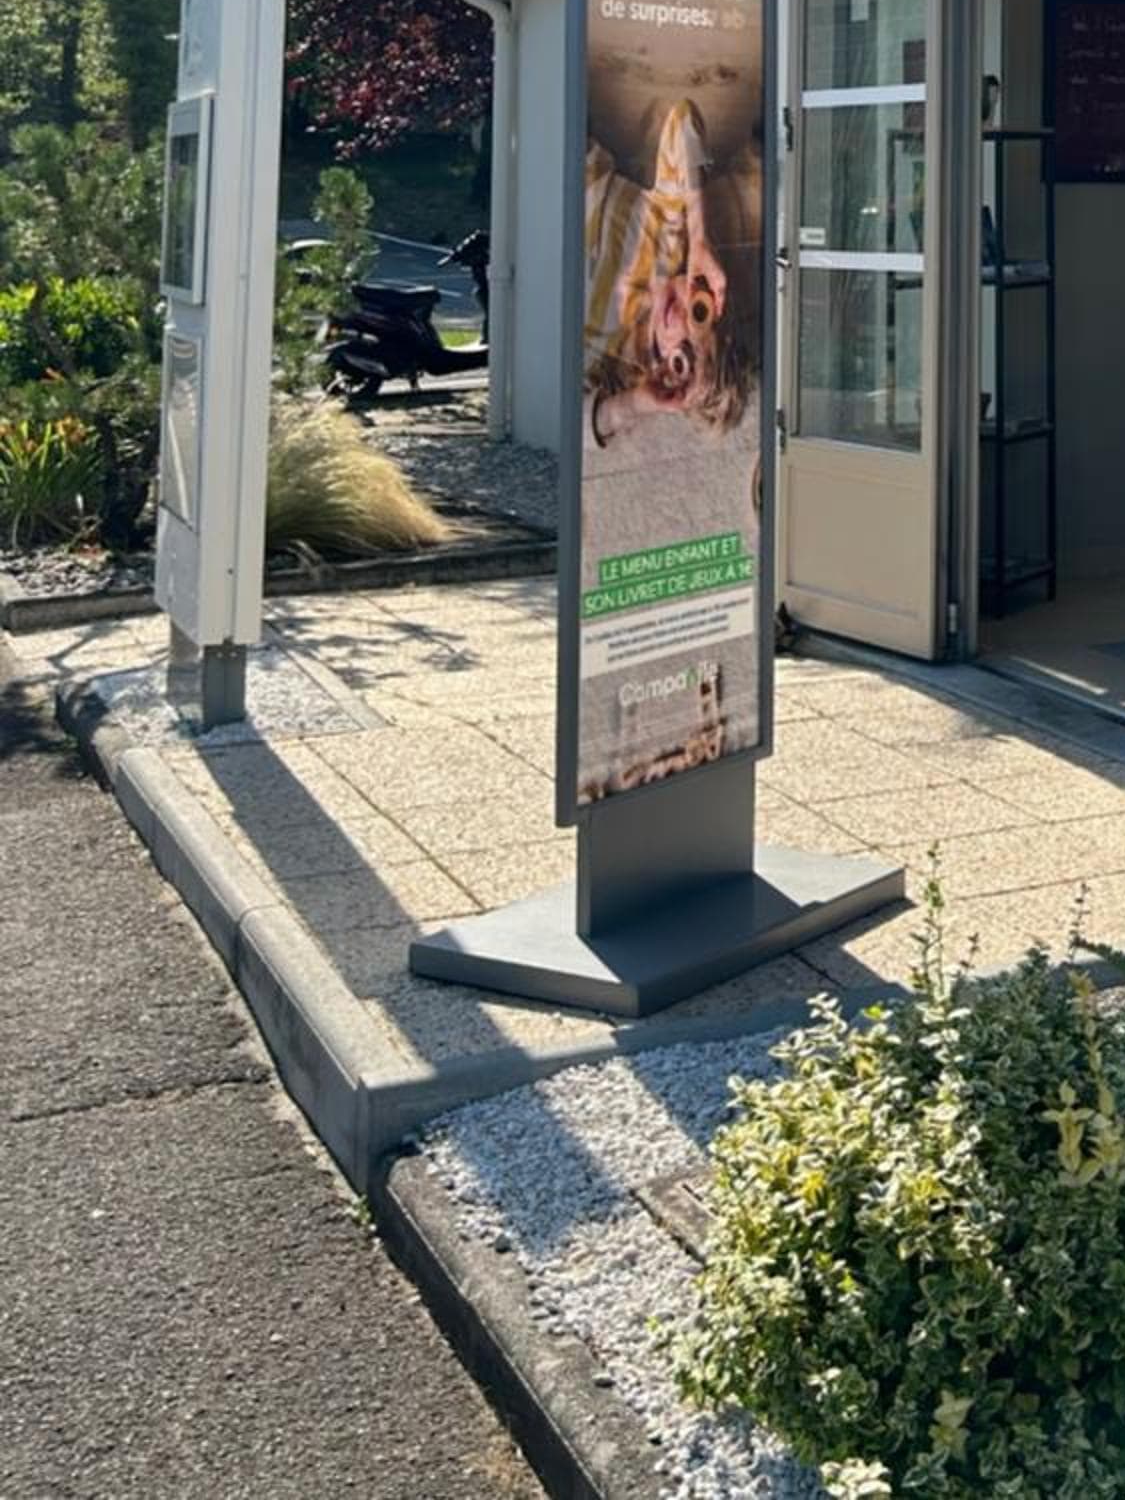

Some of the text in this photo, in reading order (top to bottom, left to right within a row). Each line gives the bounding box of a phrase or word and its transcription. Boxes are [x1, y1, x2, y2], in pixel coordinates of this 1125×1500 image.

[630, 2, 714, 27] surprises.
[602, 536, 738, 581] LE MENU ENFANT ET
[584, 592, 615, 614] SON
[617, 581, 665, 606] LIVRET
[667, 574, 687, 594] DE
[690, 565, 725, 590] JEUX
